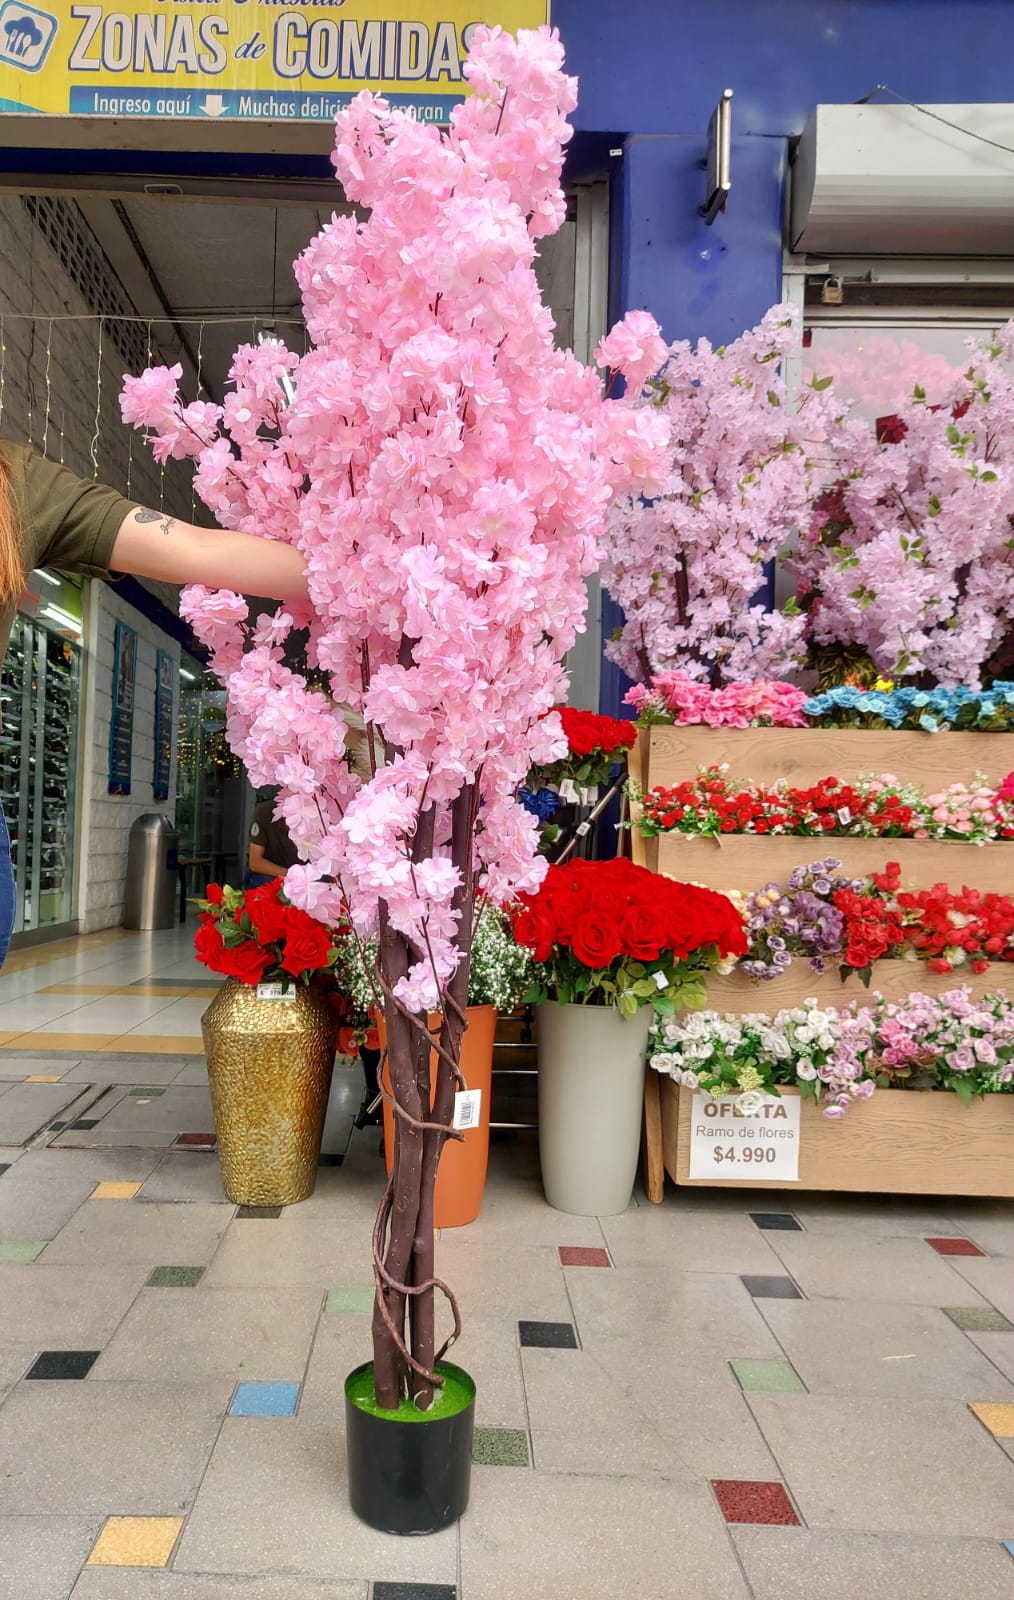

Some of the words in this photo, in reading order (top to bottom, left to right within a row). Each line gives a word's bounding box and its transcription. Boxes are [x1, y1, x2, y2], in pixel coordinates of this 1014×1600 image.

[68, 5, 229, 75] ZONAS
[234, 32, 266, 59] de
[94, 92, 150, 114] Ingreso
[156, 94, 192, 115] aquí
[238, 96, 296, 117] Muchas
[301, 97, 349, 117] delici
[703, 1102, 788, 1119] OFETA
[696, 1125, 735, 1138] Ramo
[738, 1126, 755, 1138] de
[759, 1127, 795, 1139] flores
[713, 1145, 776, 1164] $4.990
